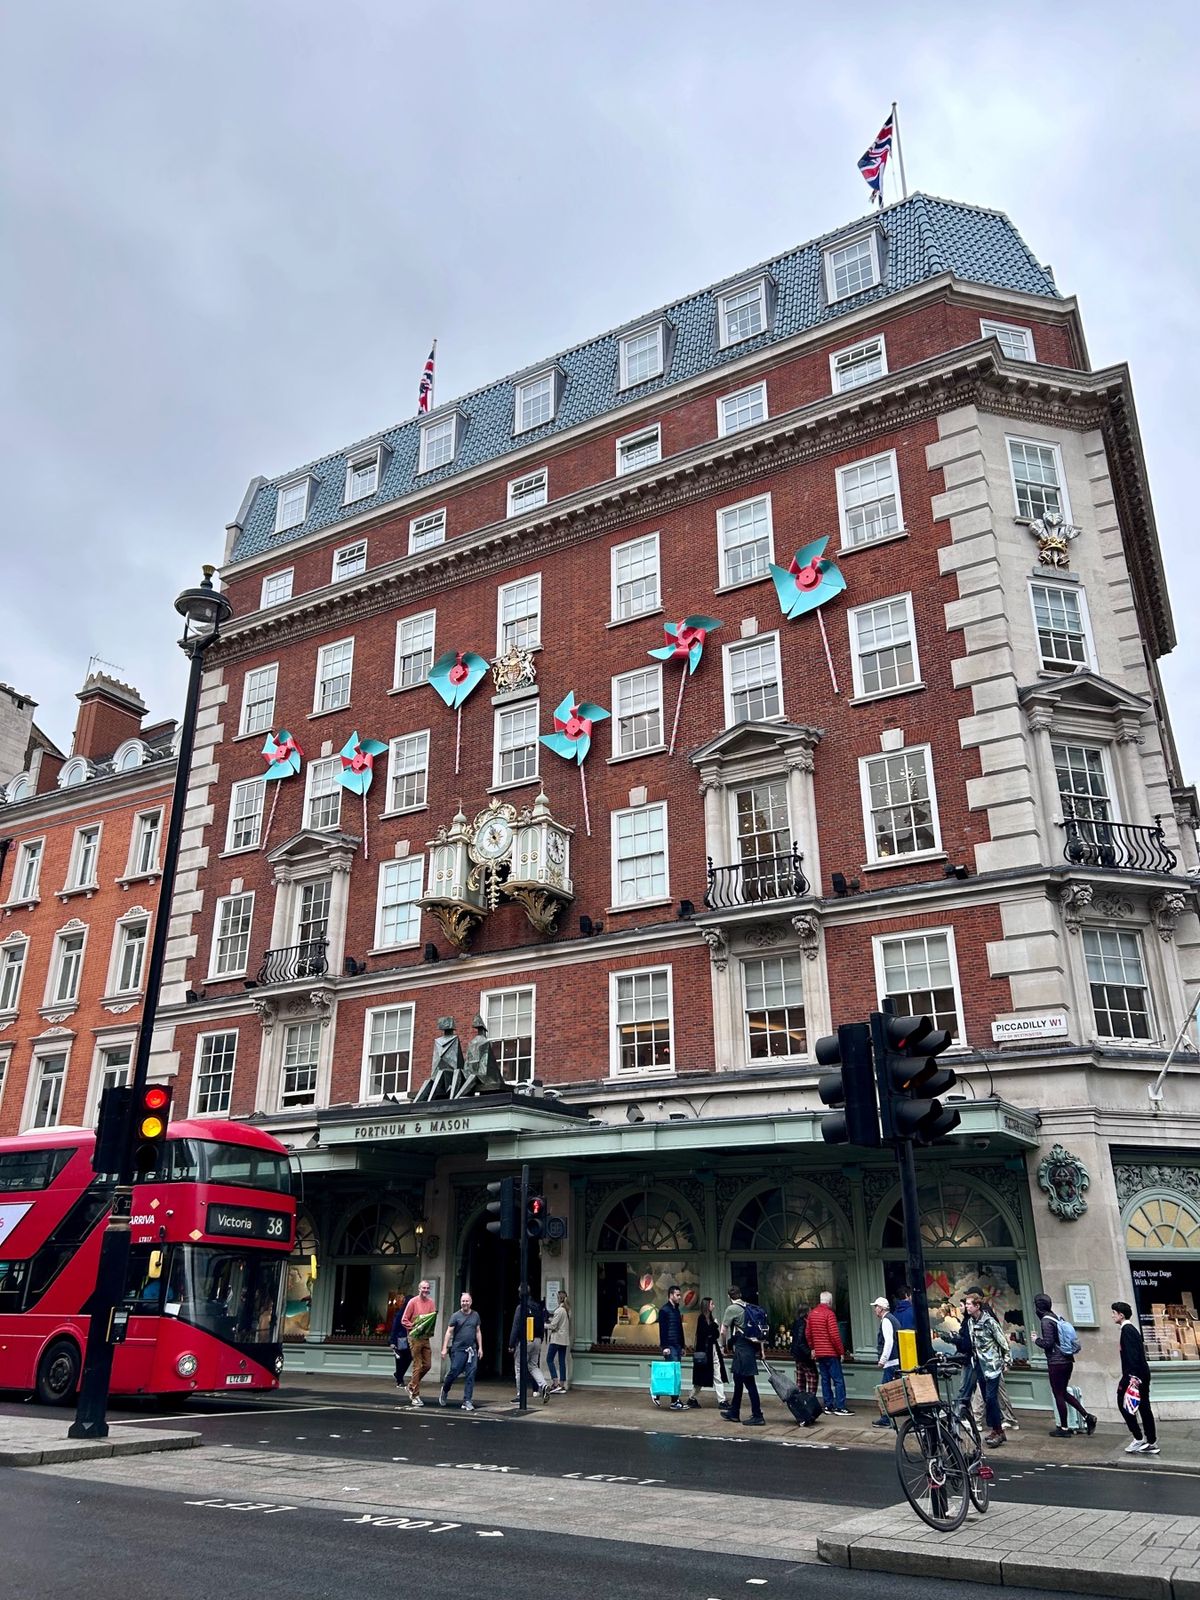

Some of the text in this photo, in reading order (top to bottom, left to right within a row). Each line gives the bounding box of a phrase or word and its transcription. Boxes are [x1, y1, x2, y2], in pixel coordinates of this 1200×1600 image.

[996, 1018, 1062, 1032] PICCADILLY W1
[355, 1118, 470, 1138] FORTNUM & MASON
[129, 1215, 155, 1224] ARRIVA
[218, 1214, 252, 1229] Victoria
[266, 1217, 283, 1235] 38
[1133, 1270, 1146, 1278] Refill
[1160, 1270, 1172, 1278] Days
[1149, 1279, 1158, 1287] Joy
[435, 1463, 666, 1485] LOOK LEFT
[183, 1498, 462, 1532] LOOK LEFT
